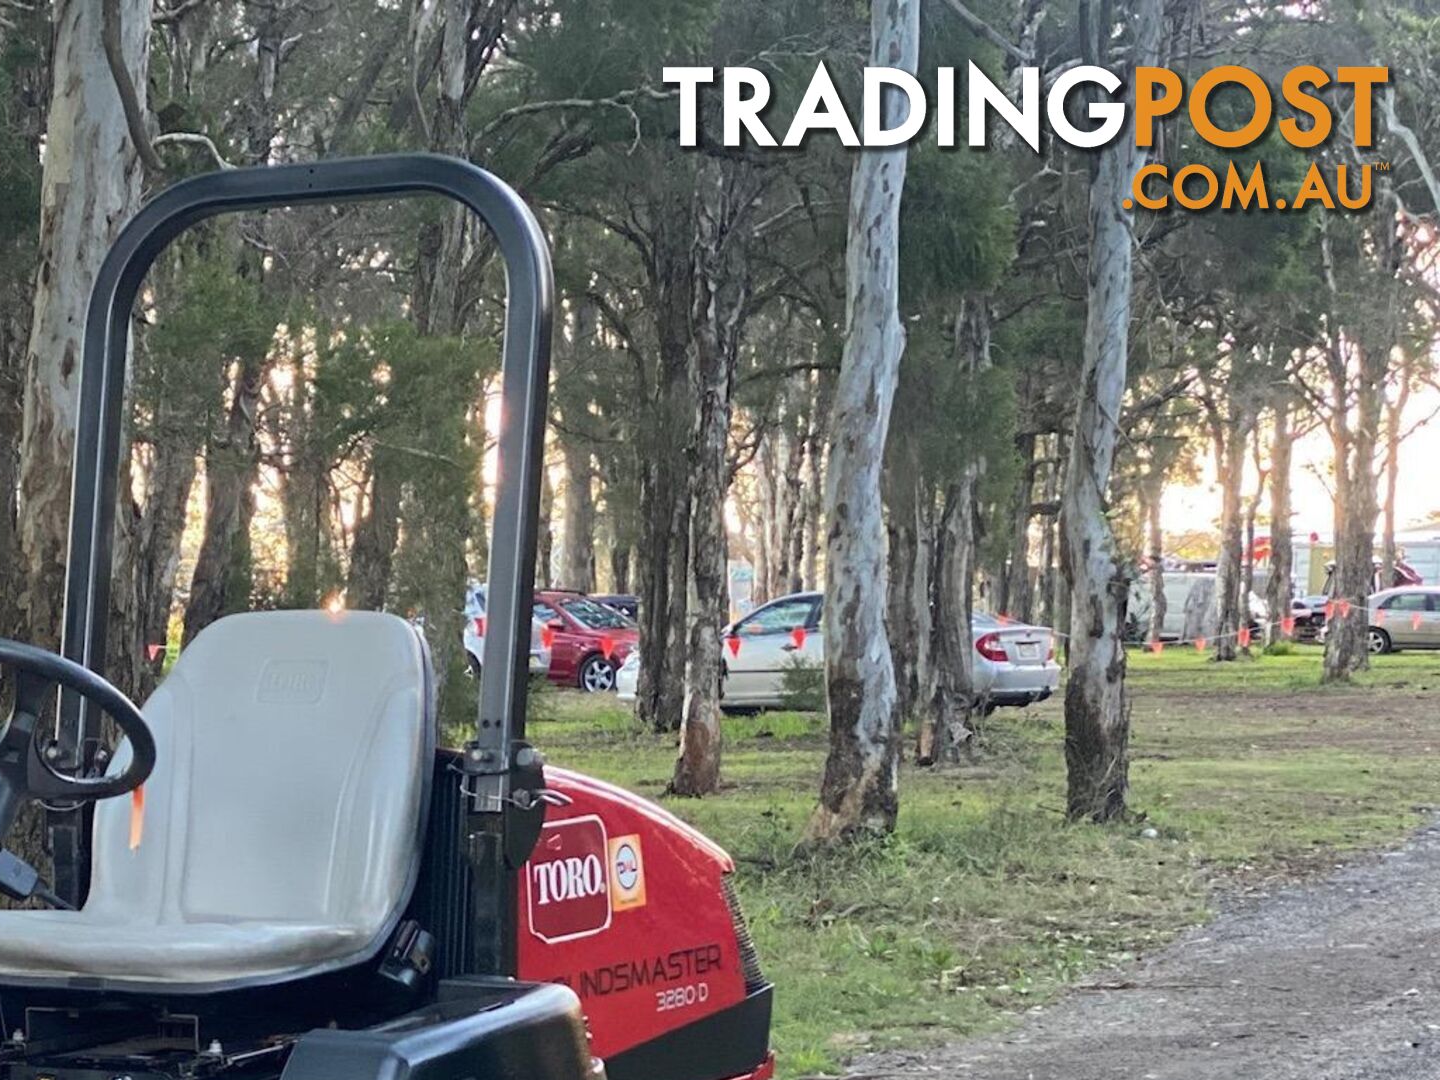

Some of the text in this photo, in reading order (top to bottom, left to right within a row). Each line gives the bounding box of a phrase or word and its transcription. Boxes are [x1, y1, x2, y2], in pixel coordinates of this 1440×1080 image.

[533, 853, 604, 904] TORO
[655, 982, 709, 1012] 3280 D
